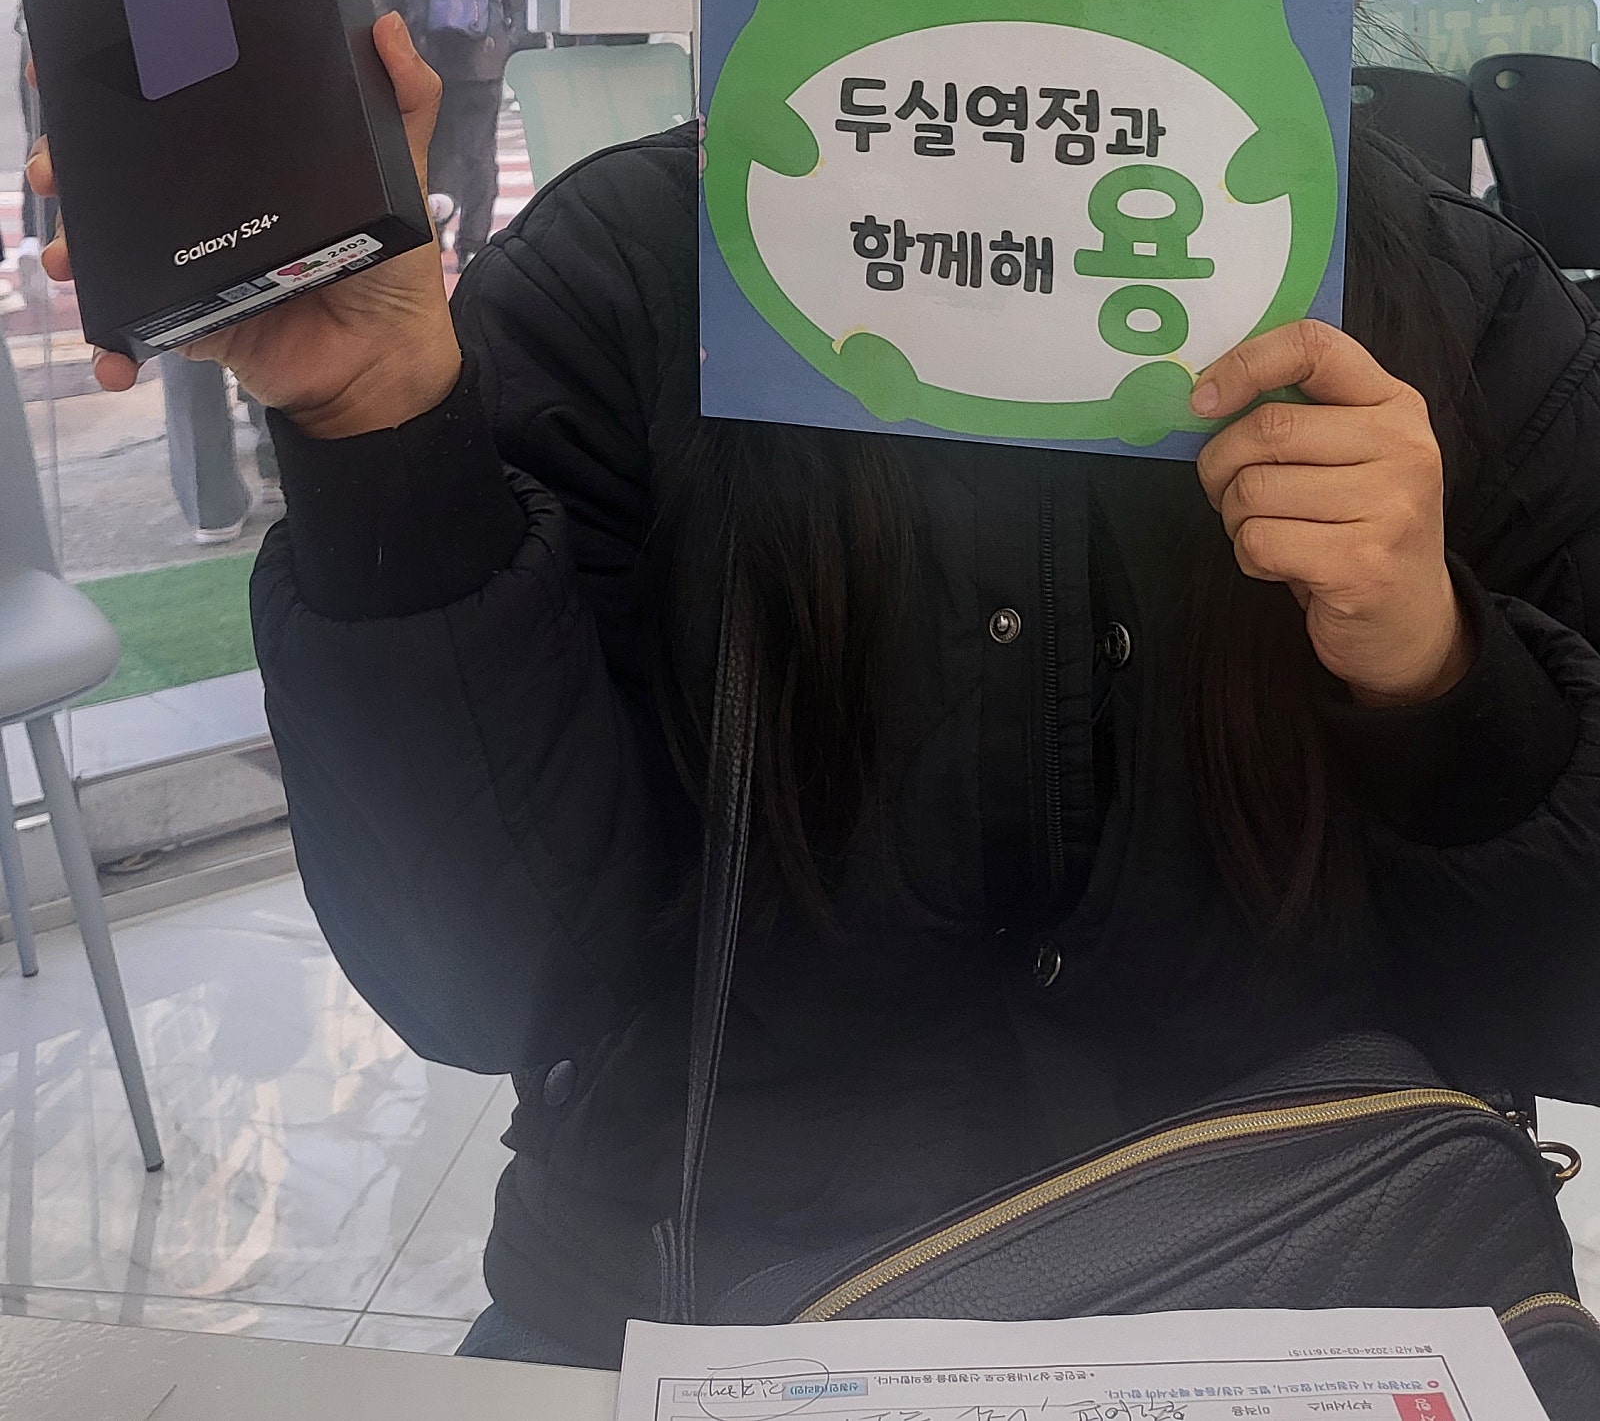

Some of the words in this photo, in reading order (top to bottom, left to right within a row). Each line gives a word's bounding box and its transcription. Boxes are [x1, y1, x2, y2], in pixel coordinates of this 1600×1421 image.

[834, 77, 1167, 166] 두실역점과
[172, 228, 238, 267] Galaxy
[239, 212, 280, 240] S24+
[327, 237, 368, 259] 2403
[850, 214, 1054, 295] 함께해
[1073, 164, 1216, 357] 용
[1053, 1370, 1087, 1381] 본인은
[1306, 1399, 1374, 1412] 부가서비스
